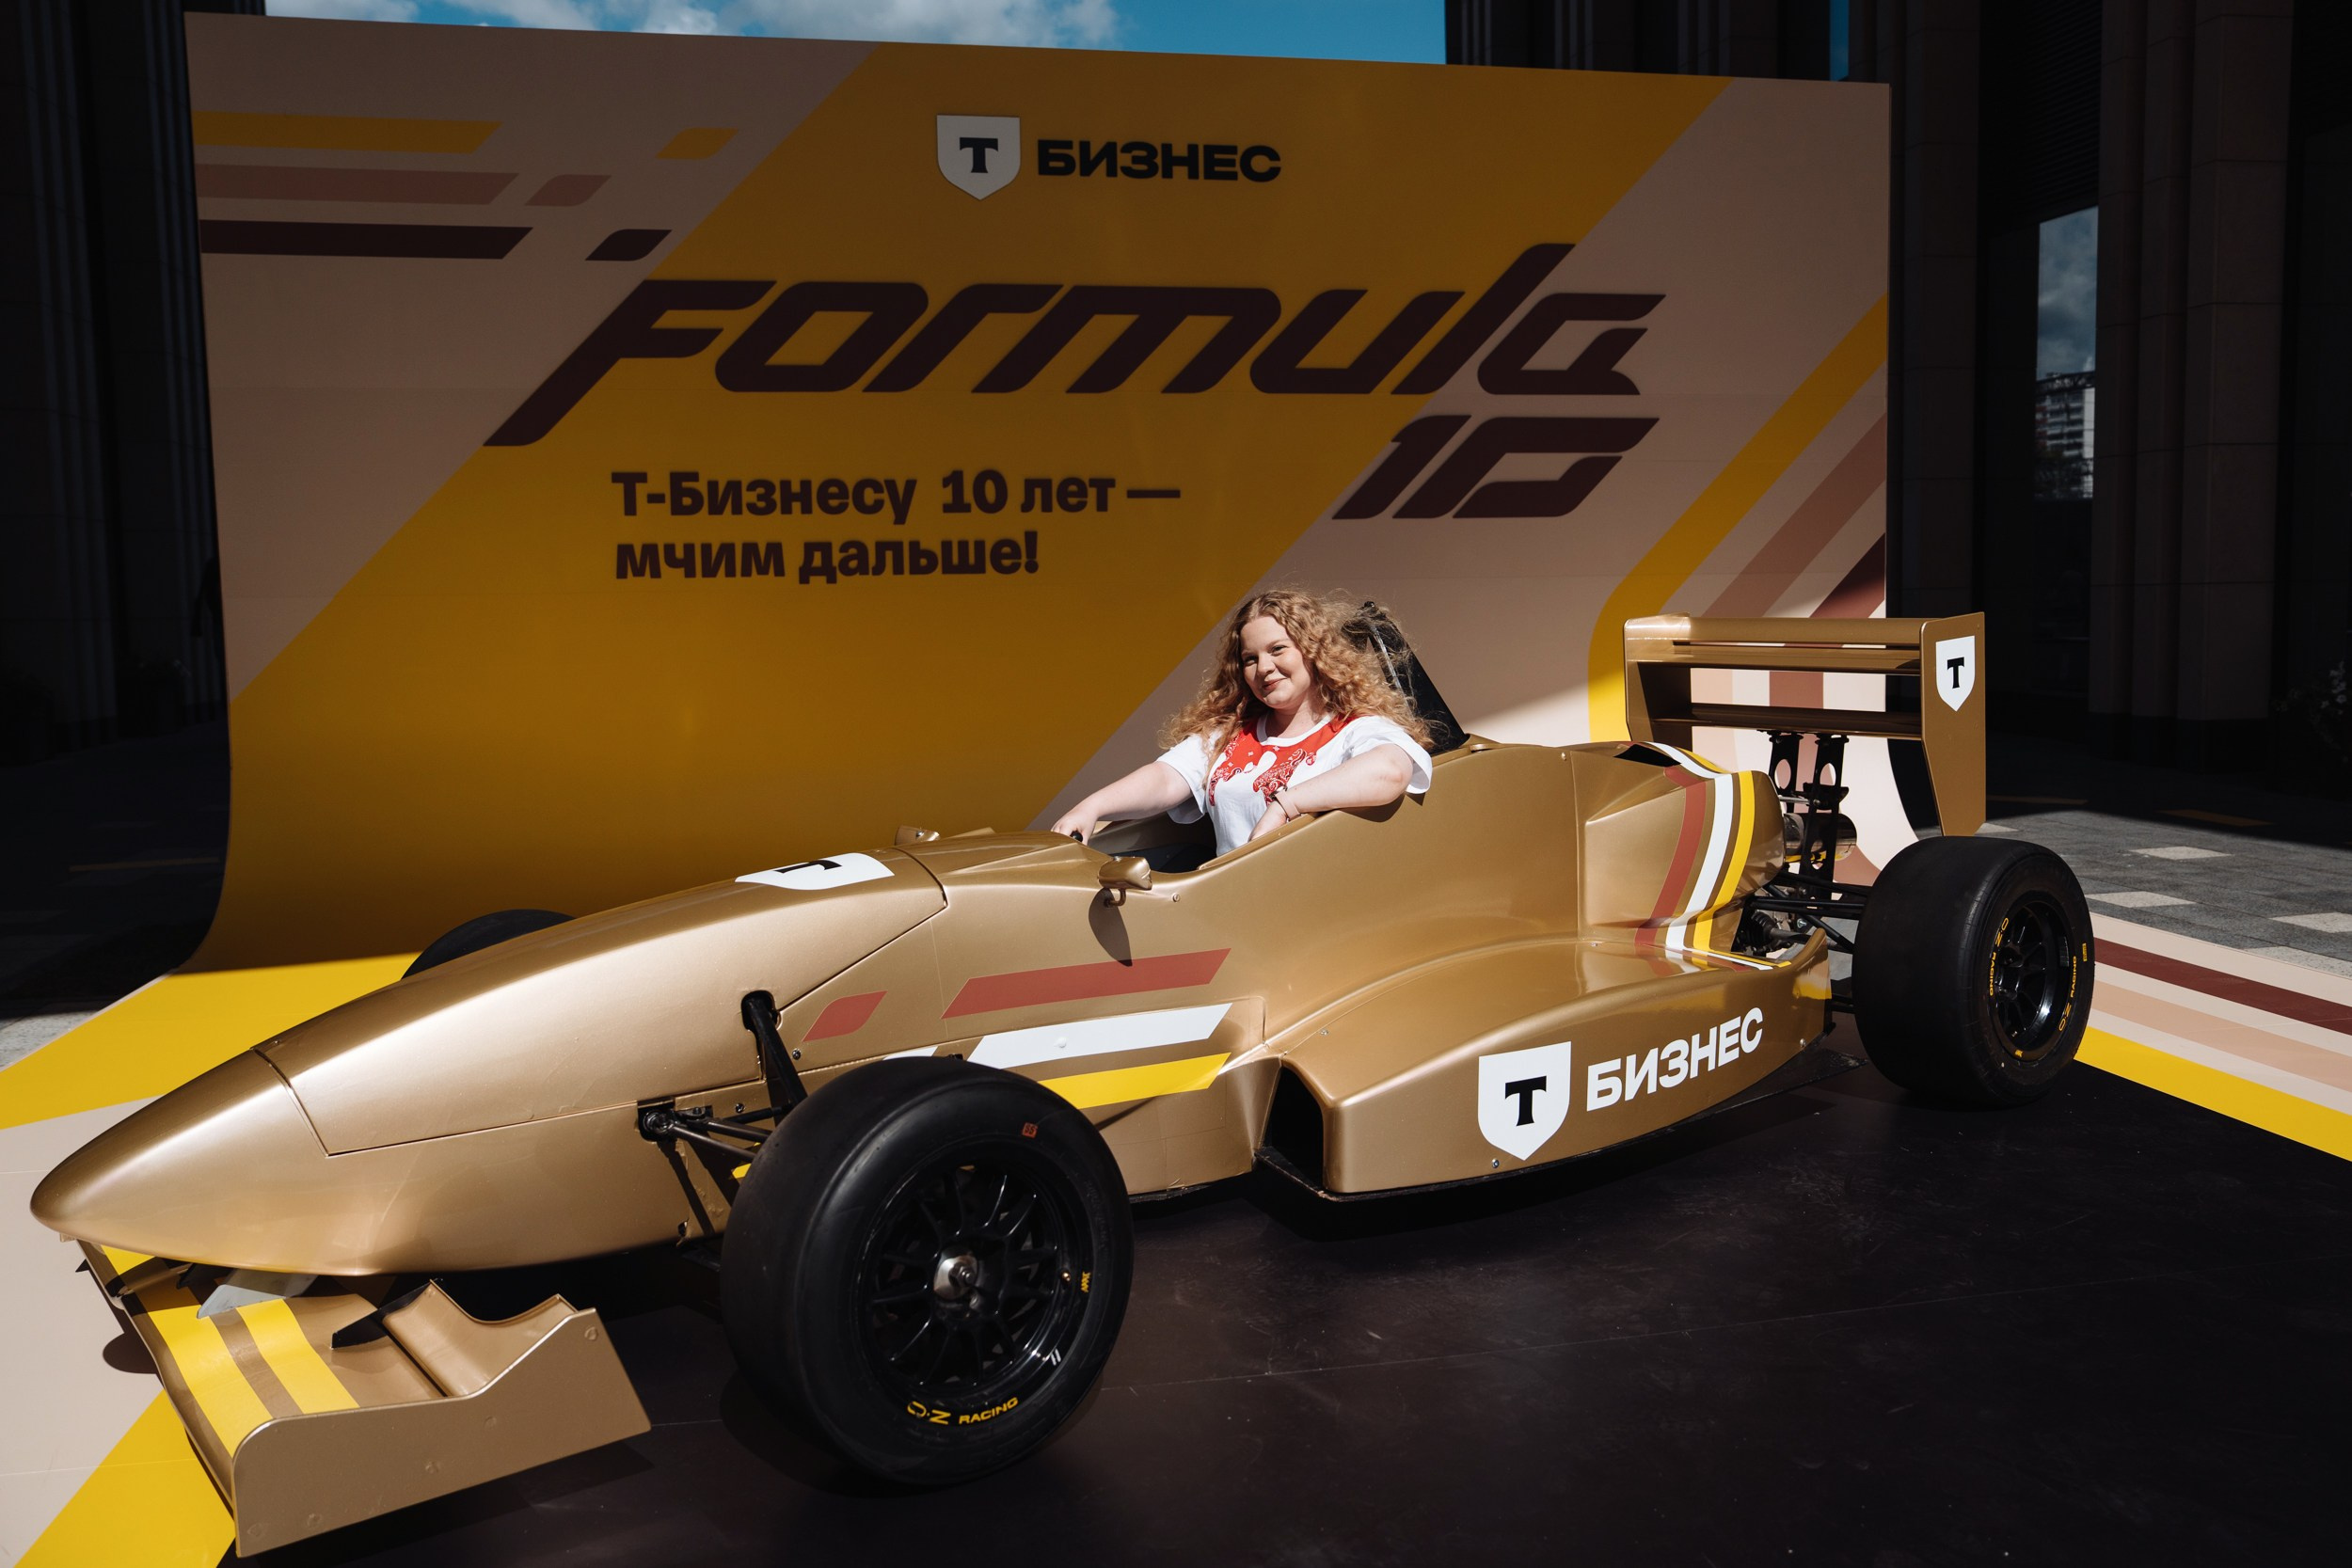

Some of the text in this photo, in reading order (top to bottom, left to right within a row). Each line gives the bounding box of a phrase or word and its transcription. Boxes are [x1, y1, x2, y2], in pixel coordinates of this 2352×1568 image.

[959, 136, 1281, 182] Т БИЗНЕС
[1331, 415, 1660, 520] 10
[612, 471, 917, 525] Т-Бизнесу
[942, 470, 1009, 514] 10
[1021, 477, 1117, 514] лет
[615, 531, 1040, 584] мчим дальше!
[1947, 657, 1965, 689] Т
[1504, 1006, 1764, 1127] Т БИЗНЕС
[958, 1396, 1020, 1425] RACING
